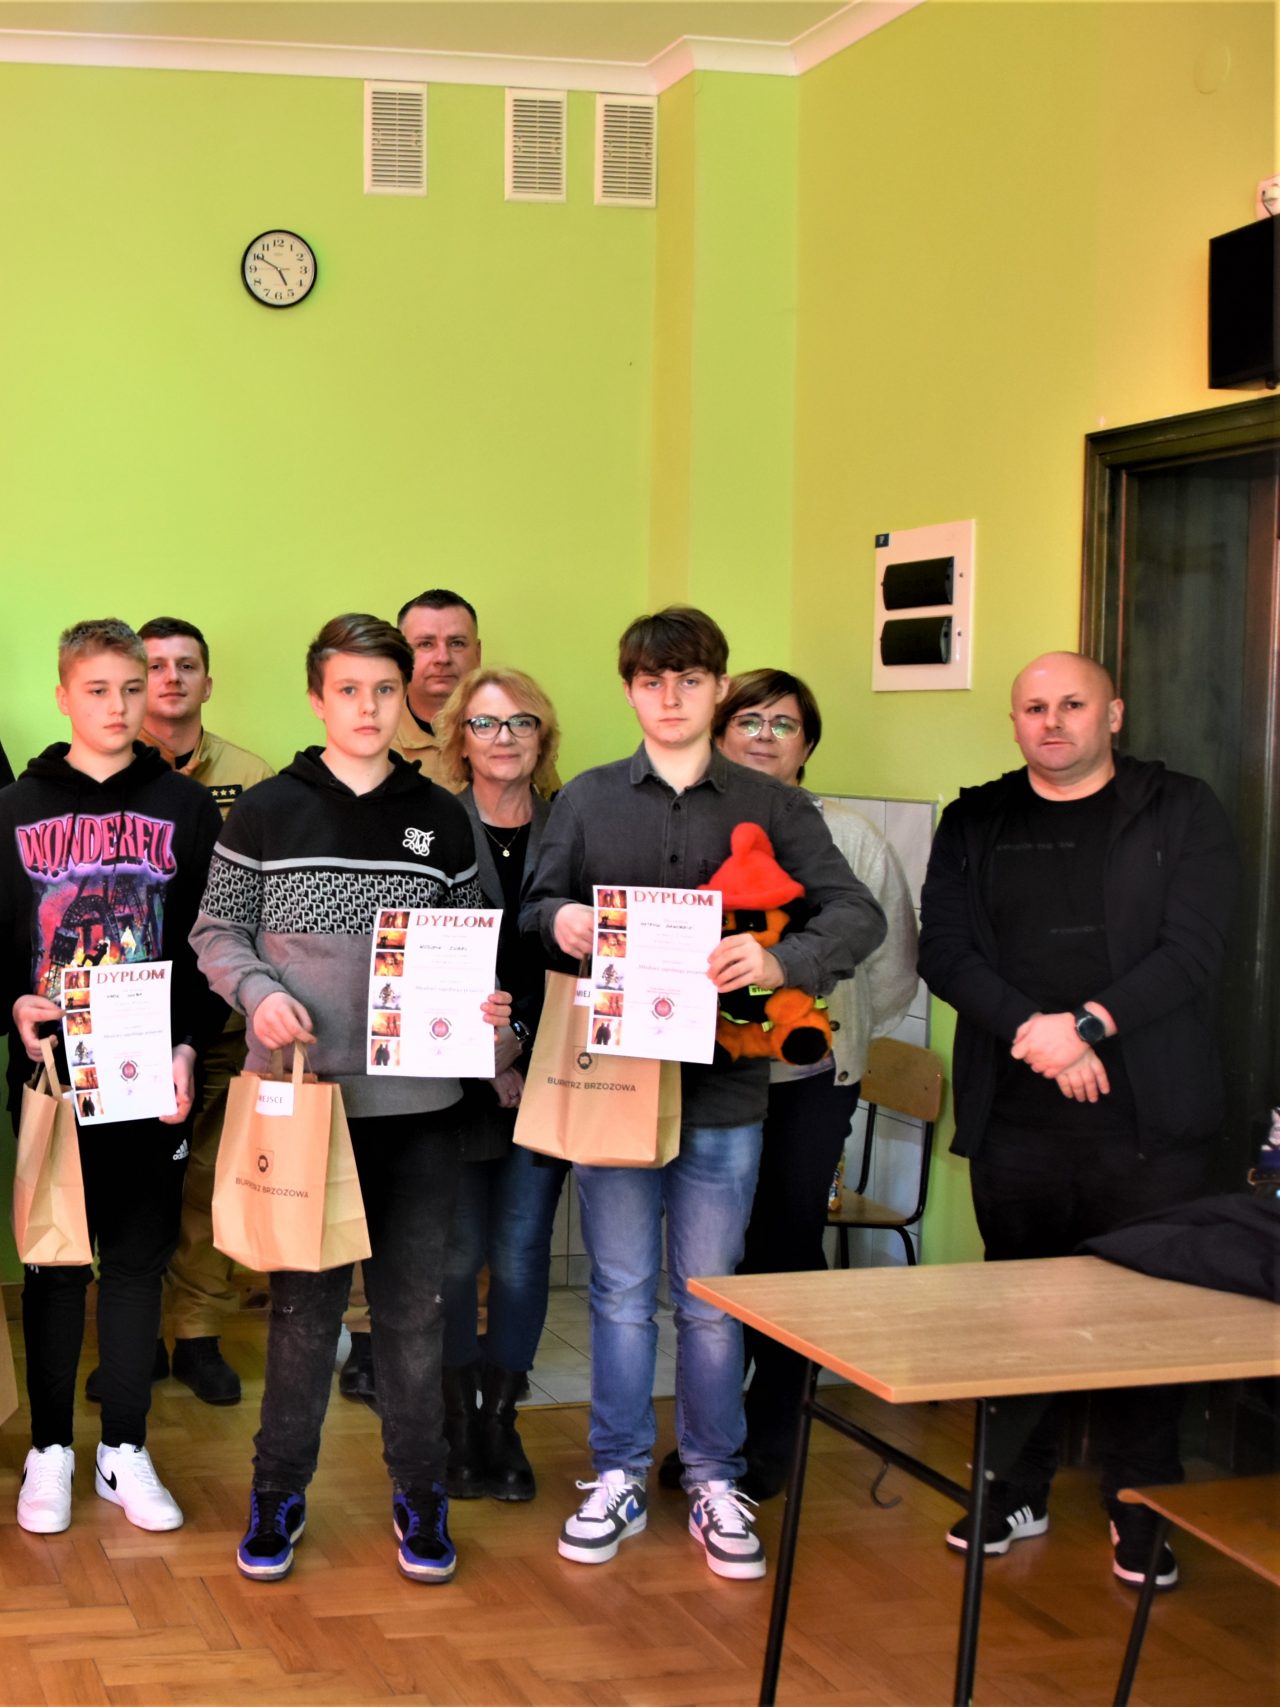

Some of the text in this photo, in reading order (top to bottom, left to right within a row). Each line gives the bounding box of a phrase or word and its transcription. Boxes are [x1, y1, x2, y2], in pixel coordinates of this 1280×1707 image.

[262, 243, 269, 251] 11
[273, 239, 285, 247] 12
[296, 253, 304, 261] 2
[249, 264, 258, 273] 9
[300, 265, 308, 274] 3
[263, 288, 271, 297] 7
[274, 292, 283, 300] 6
[287, 288, 295, 297] 5
[633, 890, 714, 907] DYPLOM
[415, 914, 494, 928] DYPLOM
[96, 968, 166, 985] DYPLOM
[584, 1082, 637, 1092] BRZOZOWA
[262, 1185, 309, 1198] BRZOZOWA
